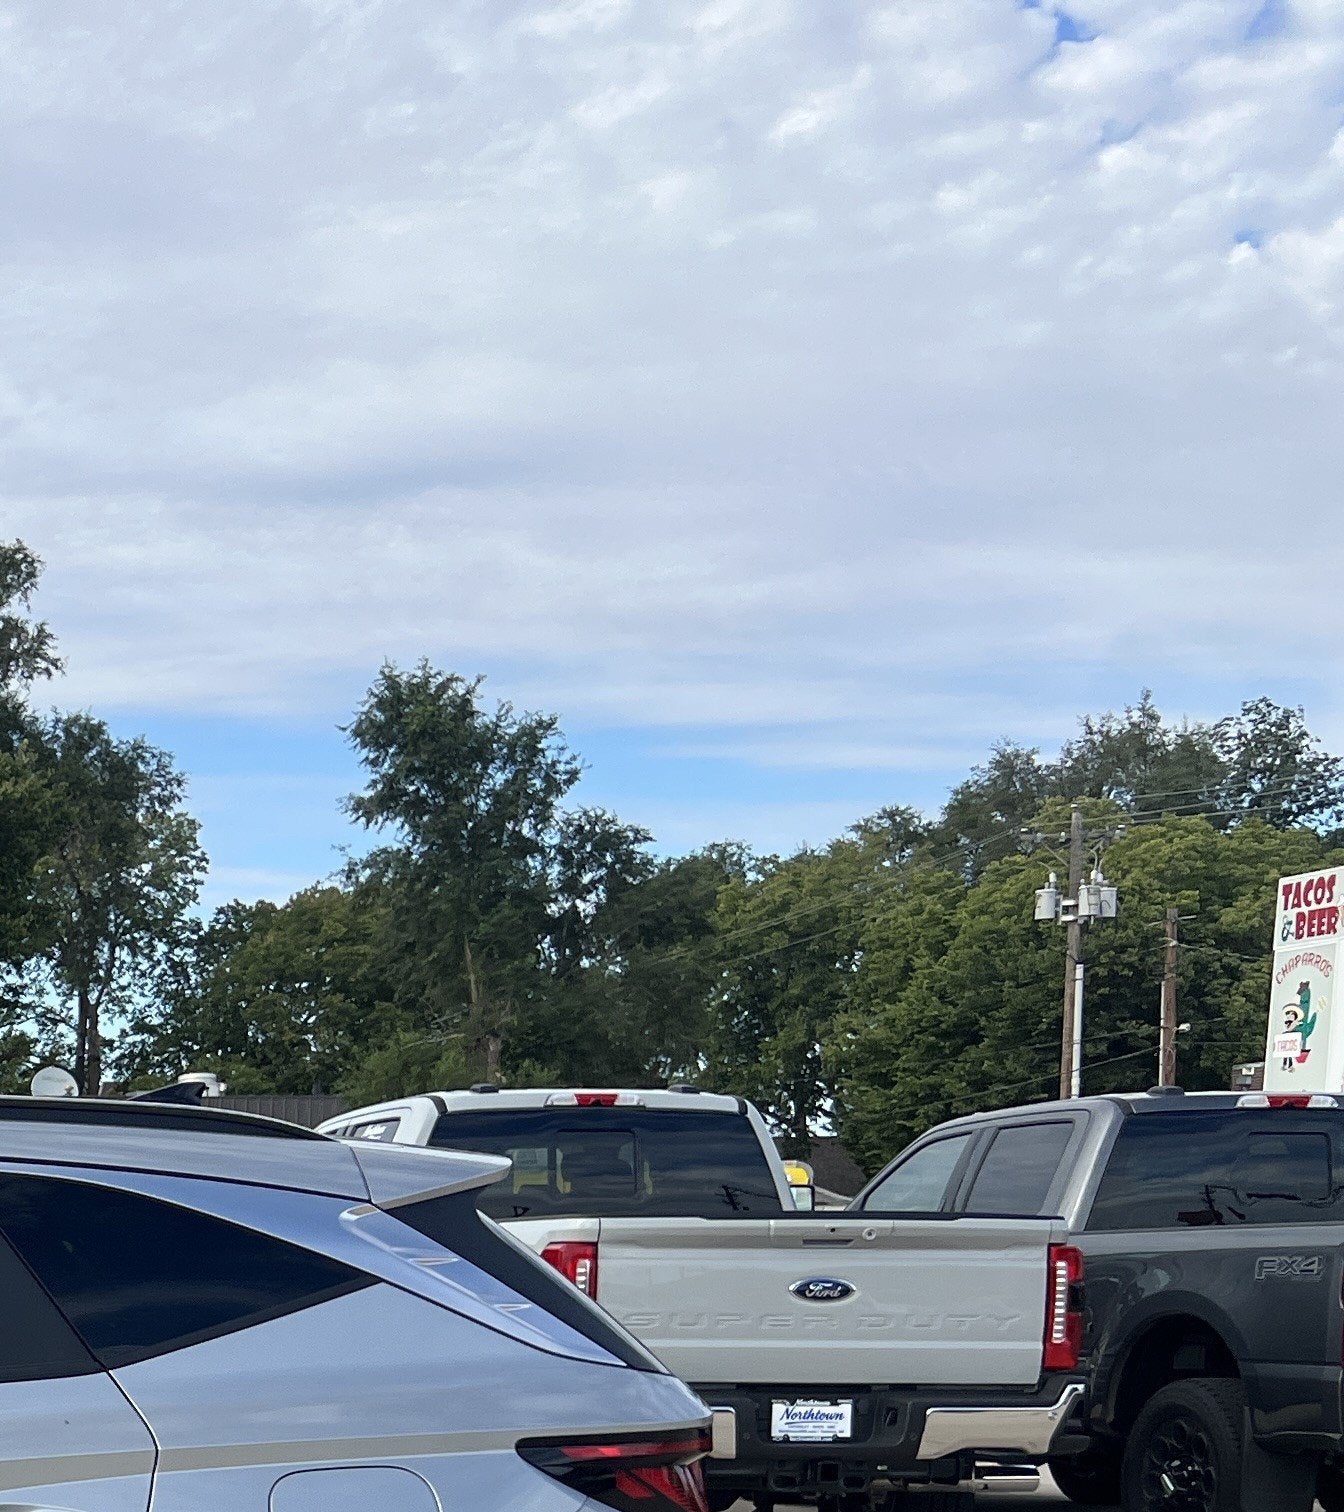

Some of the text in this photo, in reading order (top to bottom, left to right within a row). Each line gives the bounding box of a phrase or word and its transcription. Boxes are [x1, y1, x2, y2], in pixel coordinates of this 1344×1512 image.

[1282, 874, 1337, 911] TACOS
[1295, 906, 1340, 940] BEER
[1255, 1256, 1324, 1281] FX4
[805, 1282, 842, 1298] Ford
[621, 1312, 1022, 1332] SUPER DUTY
[779, 1407, 845, 1422] Northtown
